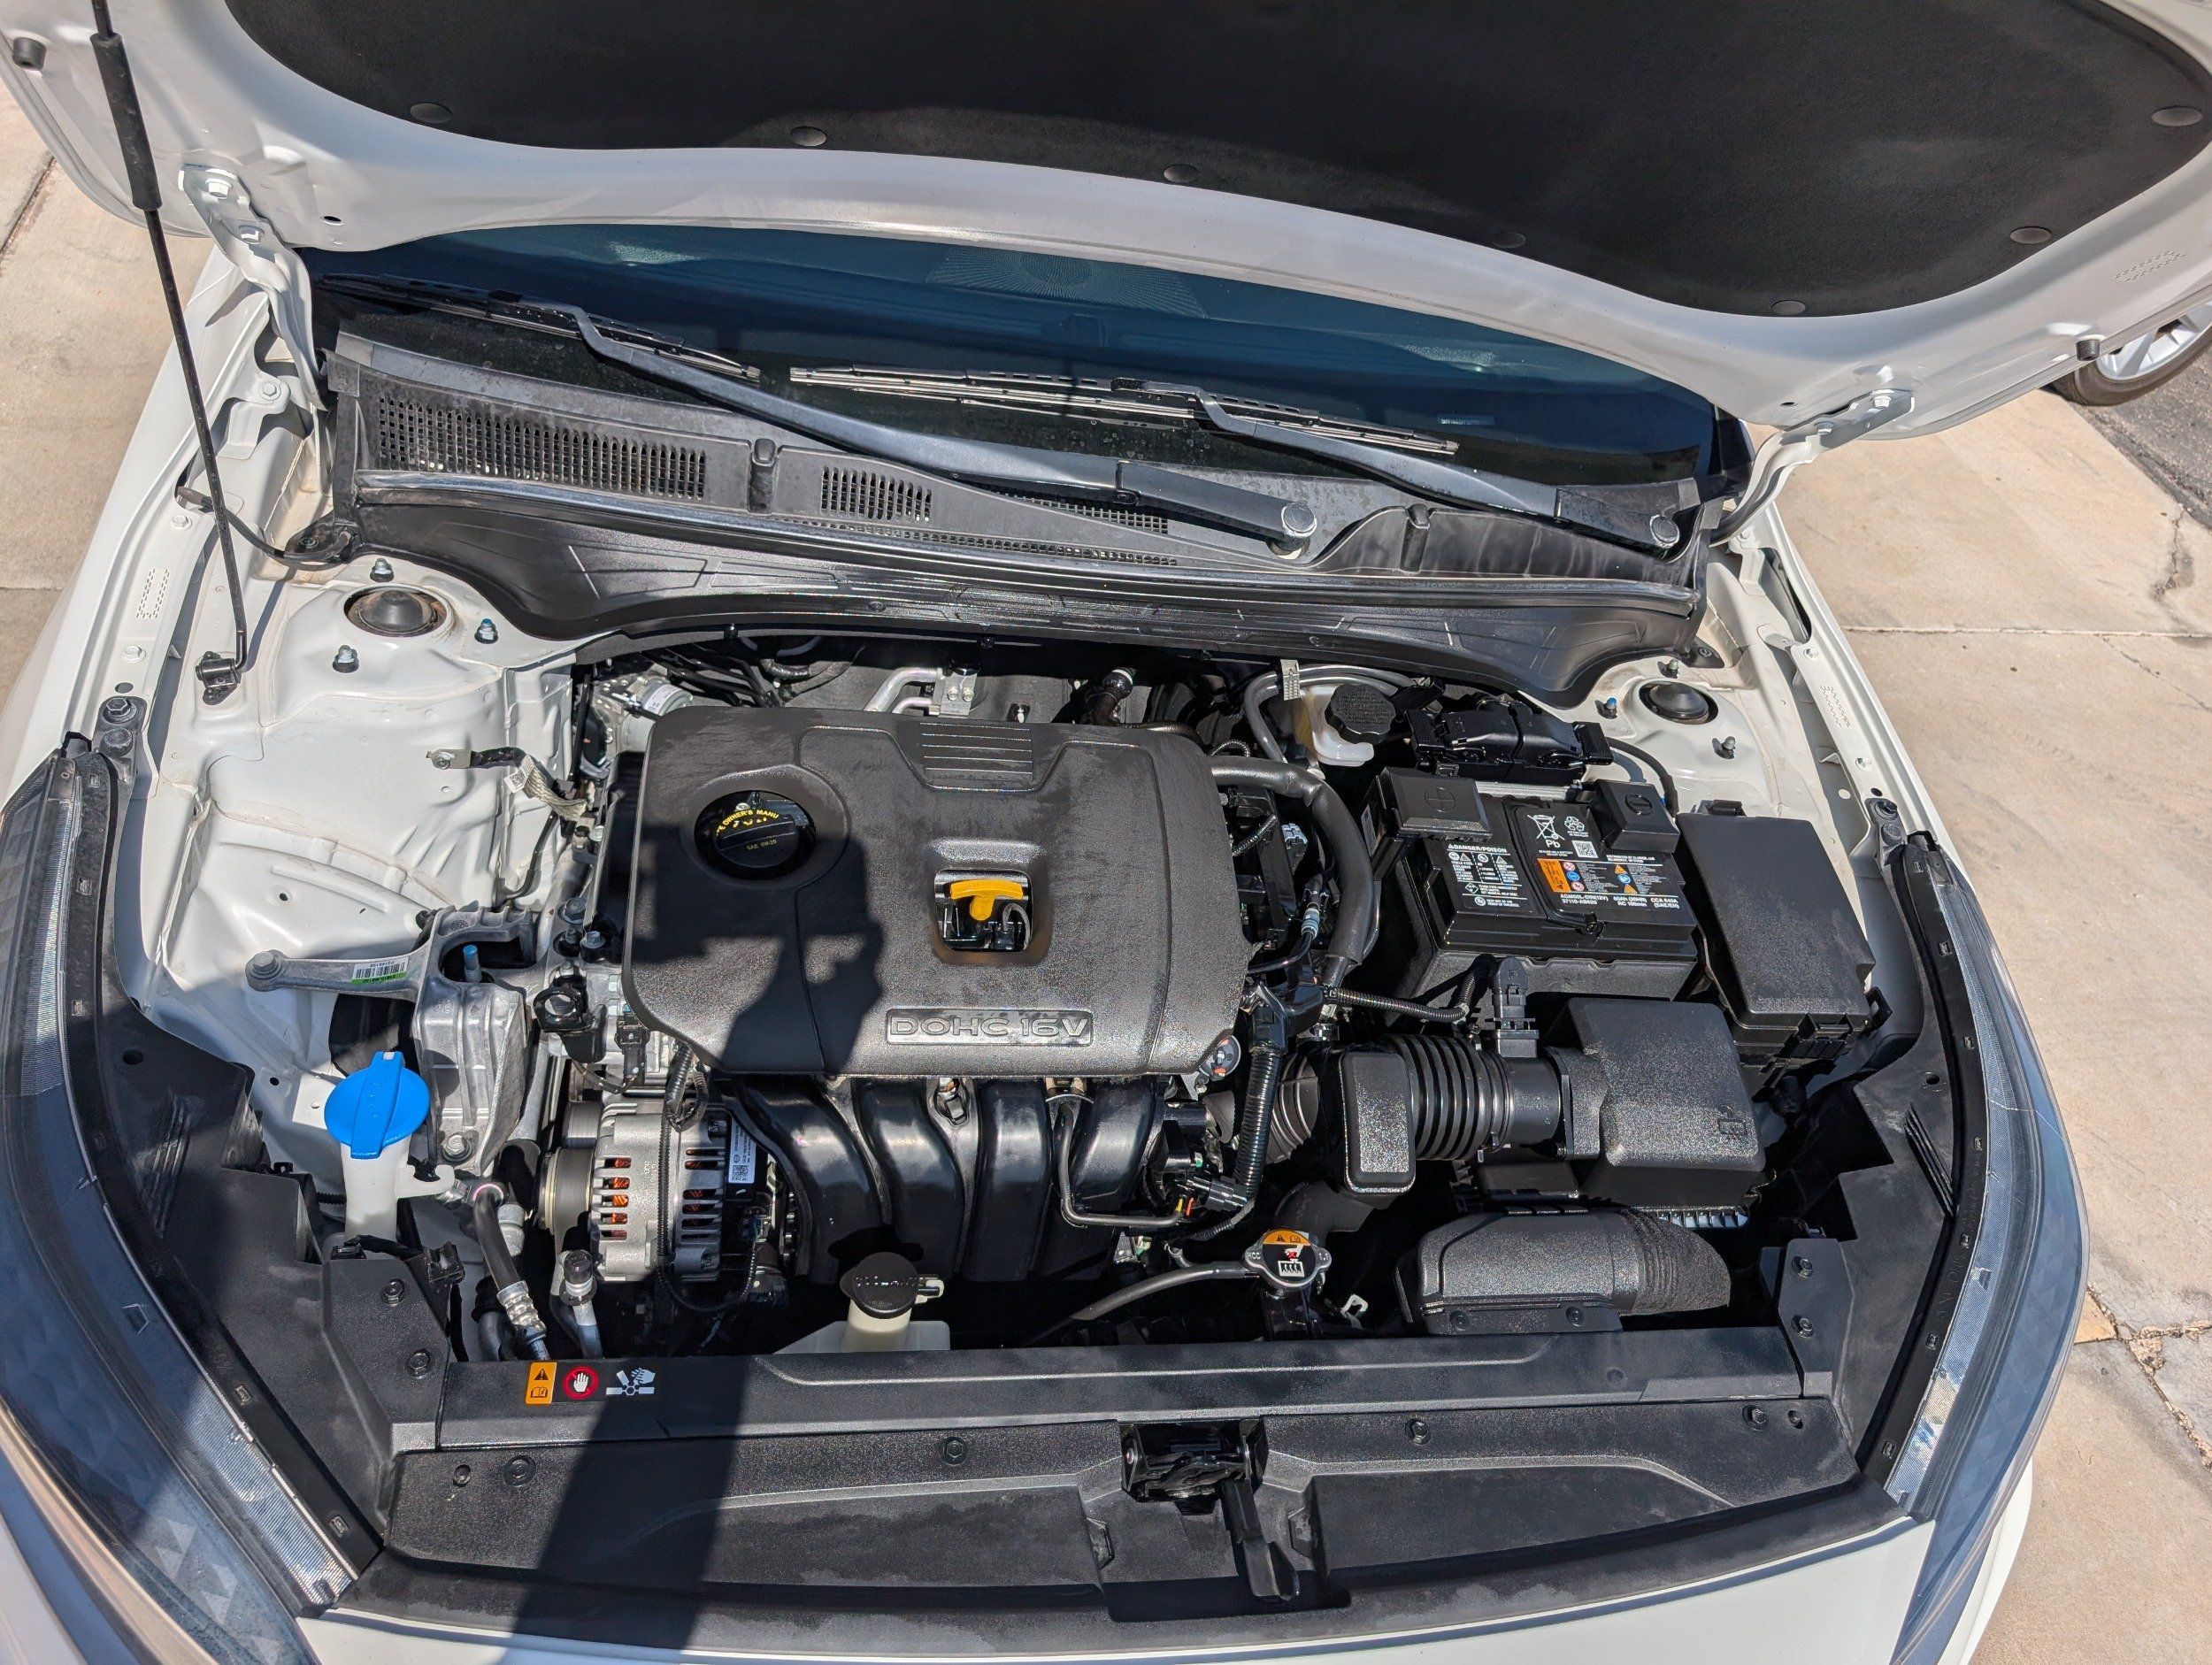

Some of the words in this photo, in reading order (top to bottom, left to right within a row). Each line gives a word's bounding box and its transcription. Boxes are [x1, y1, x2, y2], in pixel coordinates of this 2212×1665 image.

[722, 809, 753, 825] OWNER'S
[1454, 844, 1508, 853] DANGER/POISON
[1545, 839, 1561, 848] Pb
[889, 1017, 1010, 1036] DOHC
[1020, 1017, 1087, 1037] 16V
